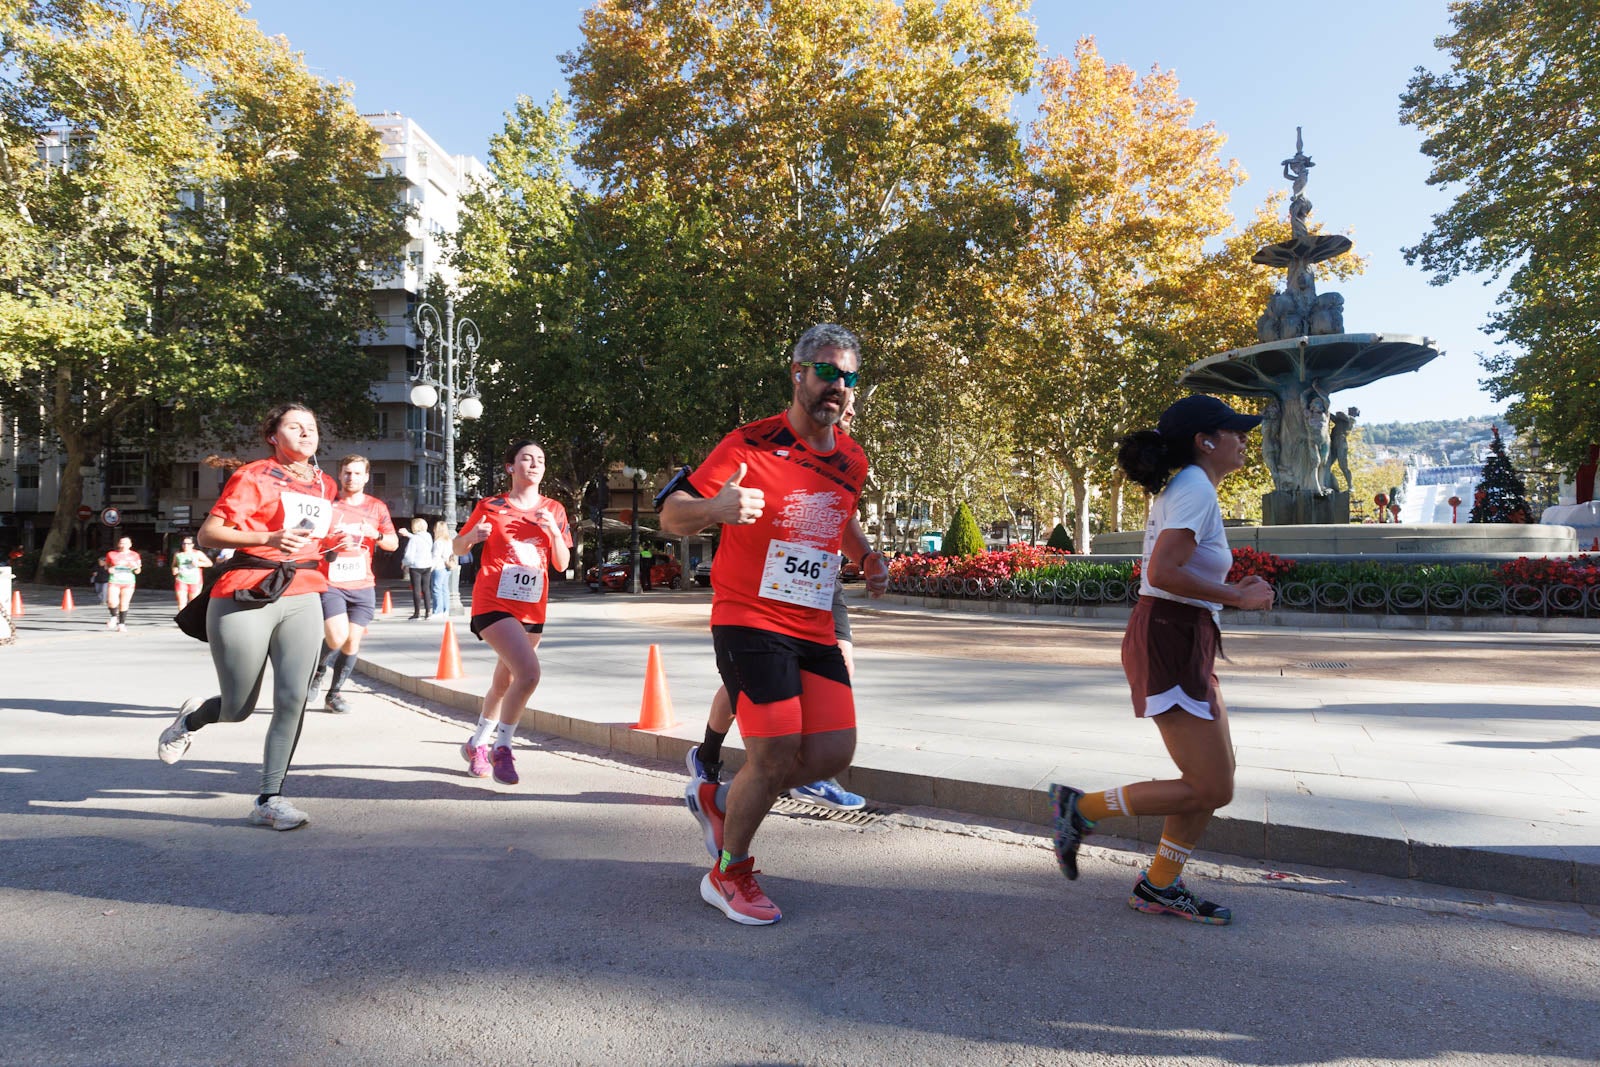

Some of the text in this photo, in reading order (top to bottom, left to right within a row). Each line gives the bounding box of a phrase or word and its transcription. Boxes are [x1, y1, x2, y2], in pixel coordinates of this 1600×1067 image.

[298, 503, 320, 518] 102
[784, 504, 842, 525] carrera
[782, 519, 840, 535] cruzroja.es
[784, 556, 821, 579] 546
[513, 573, 537, 586] 101
[1159, 845, 1186, 864] BKLYN
